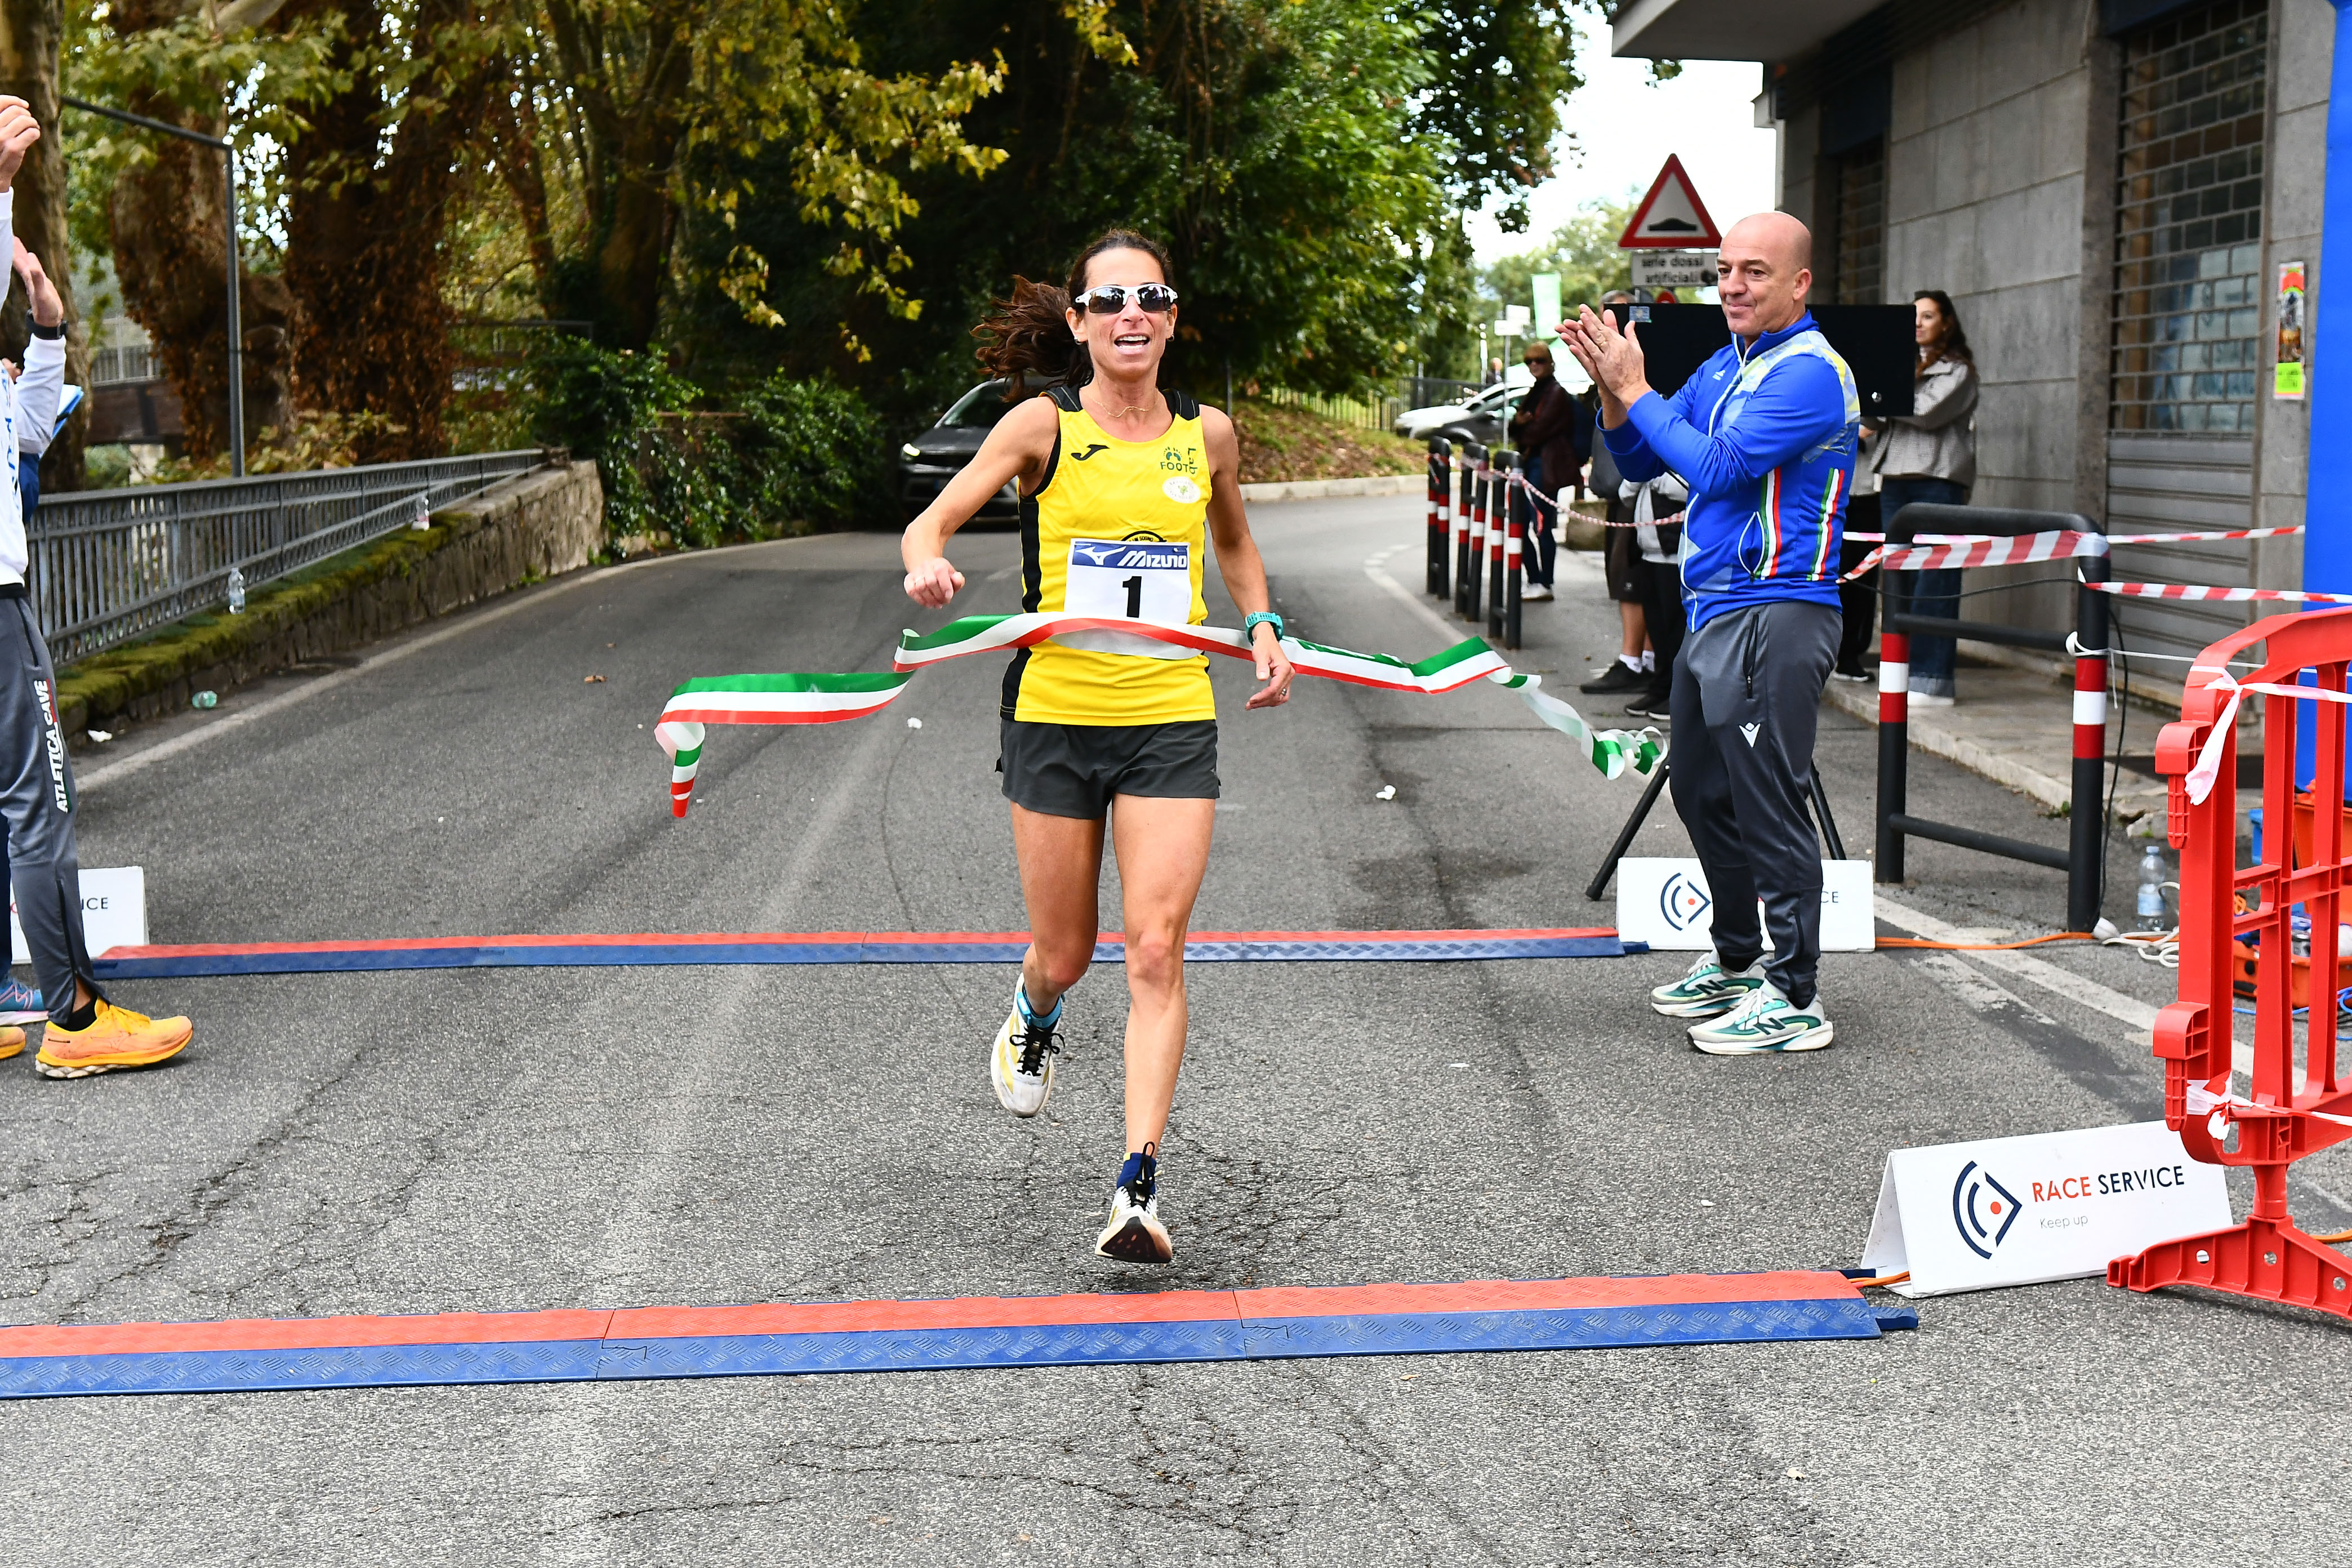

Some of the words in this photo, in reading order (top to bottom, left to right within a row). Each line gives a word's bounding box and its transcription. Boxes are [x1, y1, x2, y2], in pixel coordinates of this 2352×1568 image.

[1670, 255, 1705, 267] dossi
[1645, 271, 1699, 284] artificiali
[1160, 461, 1188, 473] FOOT
[1188, 447, 1198, 474] Lab
[1122, 576, 1142, 618] 1
[33, 680, 54, 726] CAVE
[46, 729, 68, 814] ATLETICA
[2032, 1176, 2092, 1202] RACE
[2098, 1165, 2185, 1195] SERVICE
[2039, 1217, 2070, 1229] Keep
[2073, 1215, 2088, 1227] up
